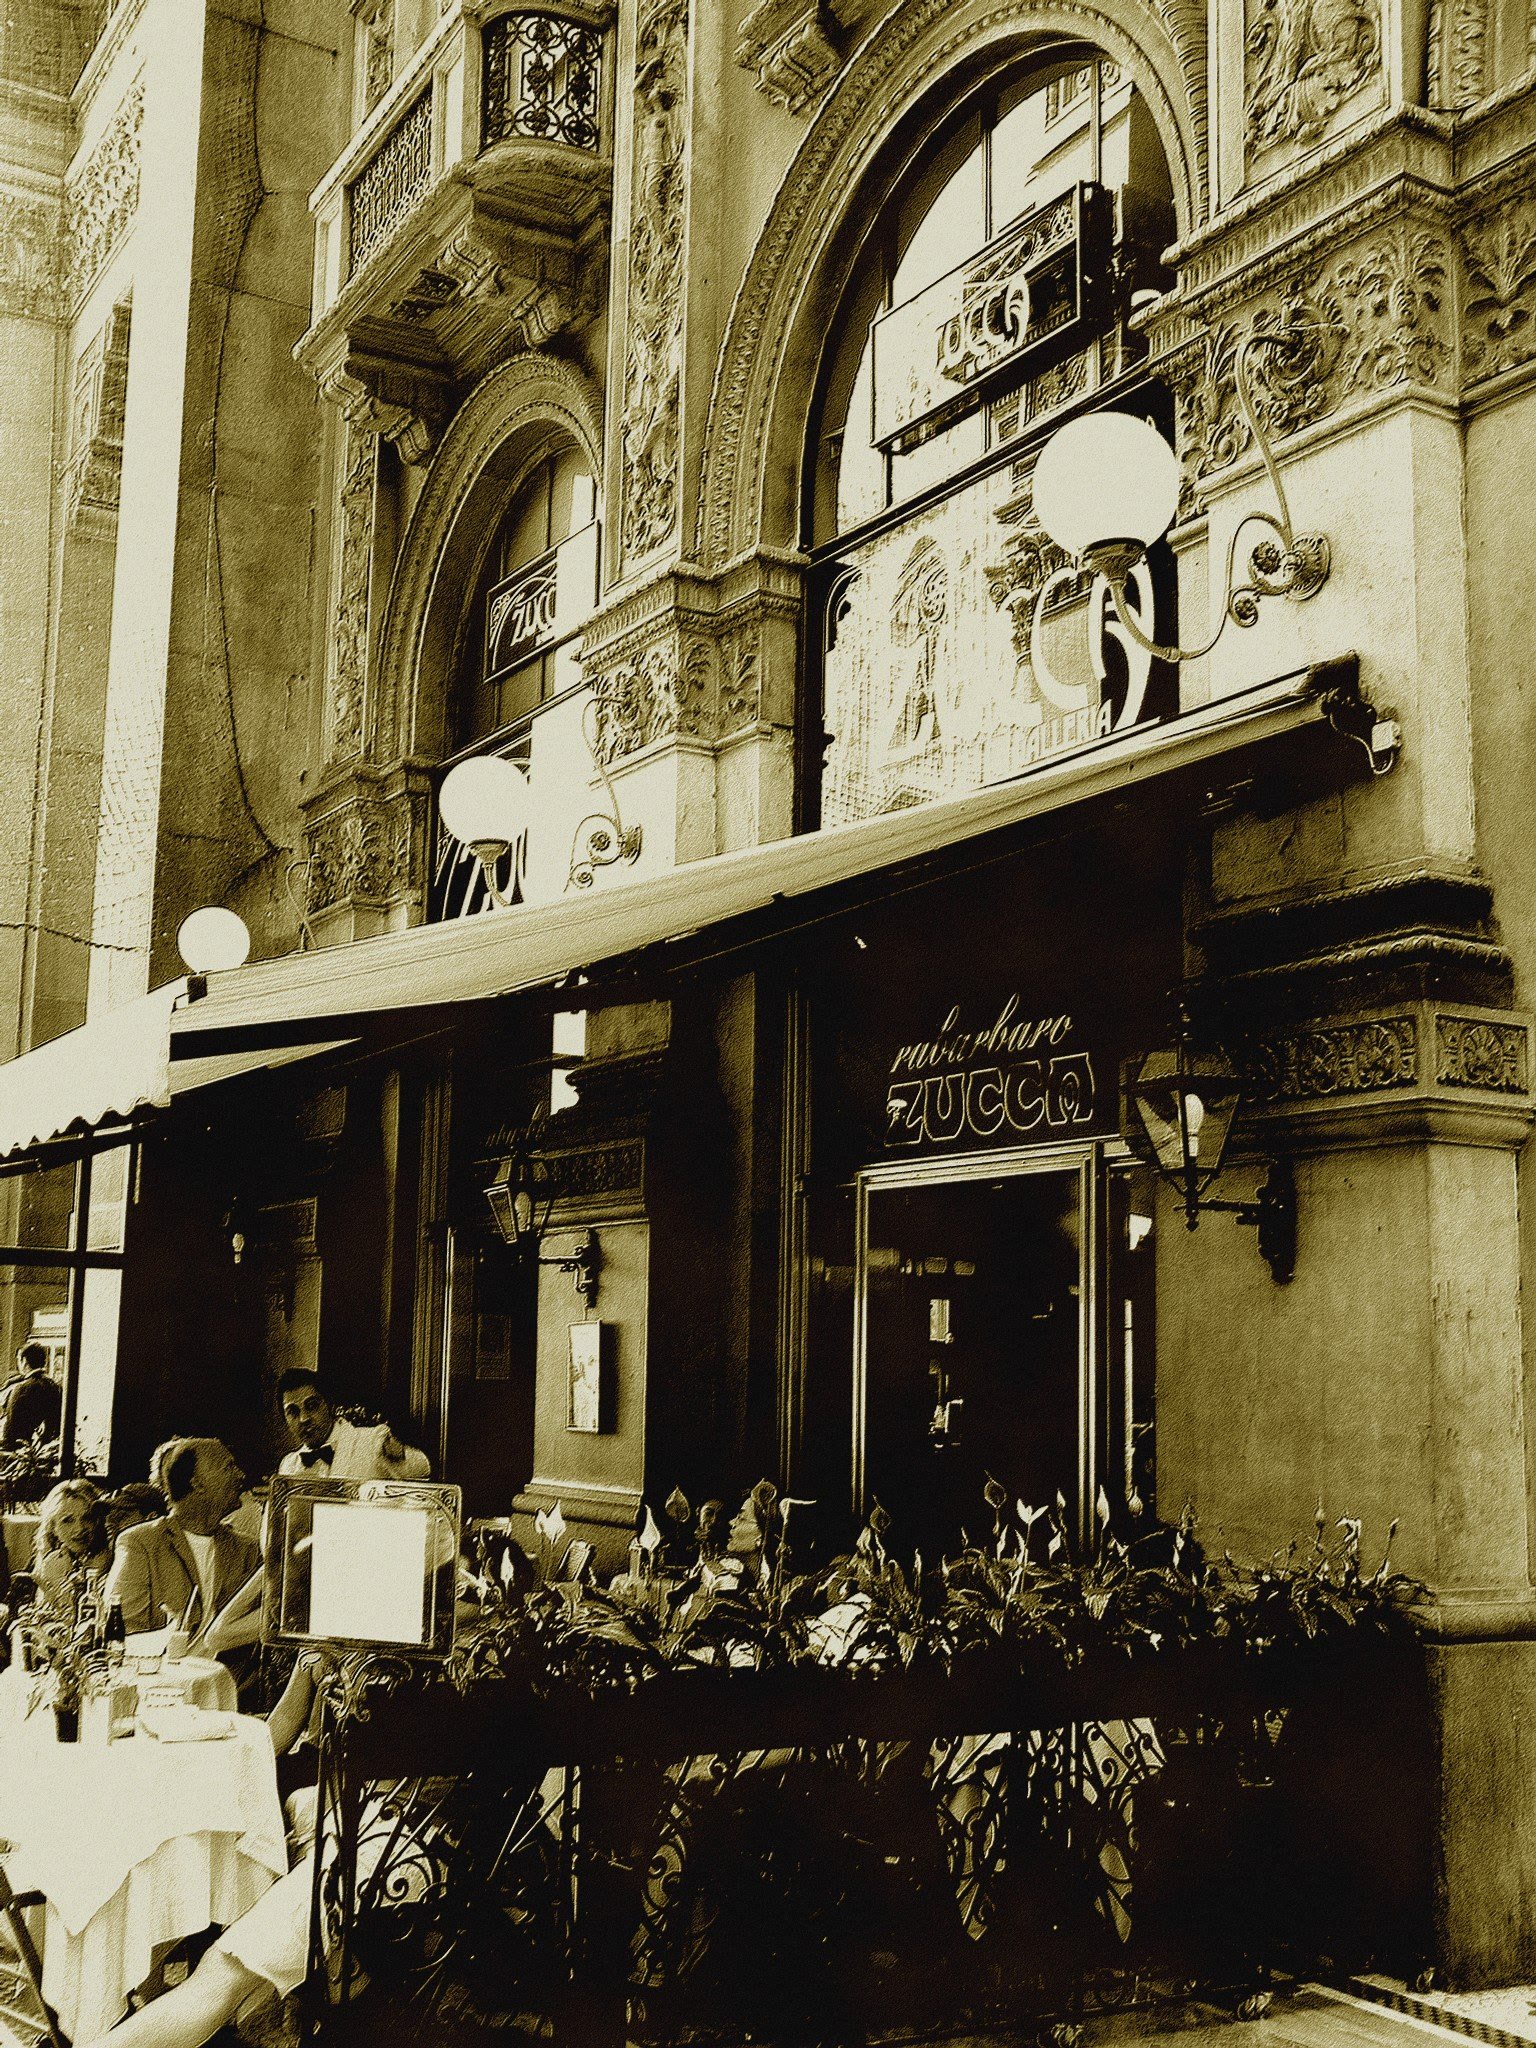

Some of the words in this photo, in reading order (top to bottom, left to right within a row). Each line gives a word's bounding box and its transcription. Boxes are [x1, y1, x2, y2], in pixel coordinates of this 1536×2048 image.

[1016, 699, 1111, 763] ALLERIA
[889, 992, 1074, 1073] rabarbaro
[884, 1052, 1094, 1147] ZUCCA
